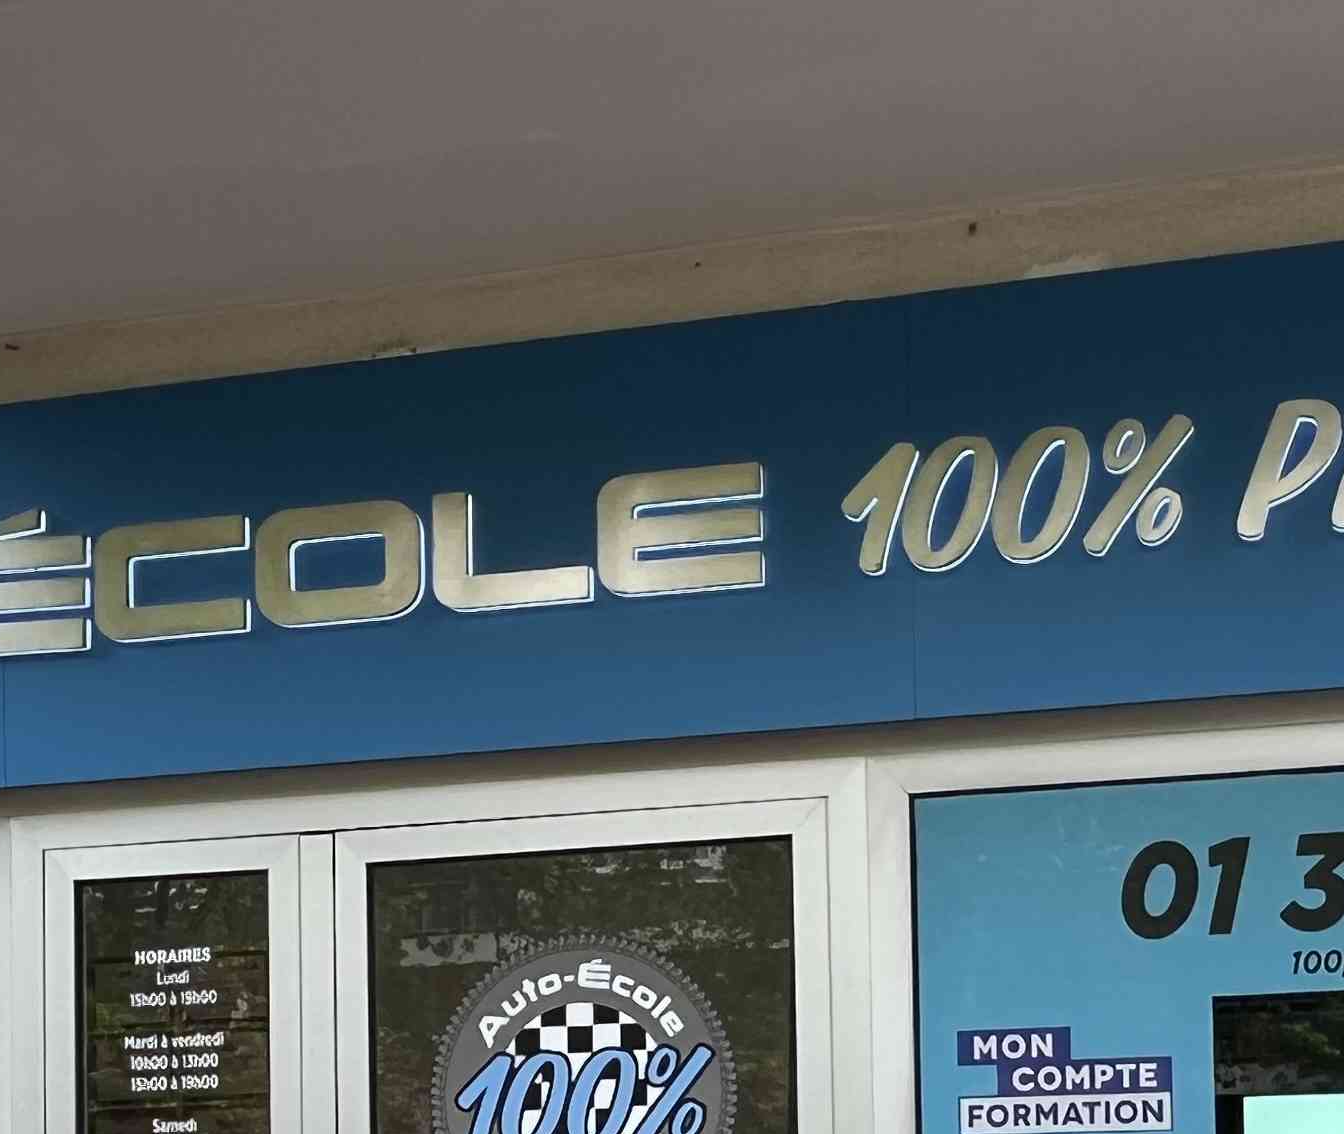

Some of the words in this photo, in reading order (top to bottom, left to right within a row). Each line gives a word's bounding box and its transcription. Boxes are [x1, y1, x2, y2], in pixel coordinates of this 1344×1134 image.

[840, 414, 1194, 575] 100%
[1121, 836, 1250, 940] 01
[134, 947, 211, 965] HORAIRES
[156, 970, 190, 986] Lundi
[478, 958, 685, 1049] Auto-École
[124, 1034, 158, 1050] Mardi
[172, 1032, 224, 1048] vendredi
[973, 1033, 1053, 1060] MON
[1012, 1063, 1157, 1092] COMPTE
[152, 1118, 197, 1134] Samedi
[967, 1099, 1164, 1128] FORMATION
